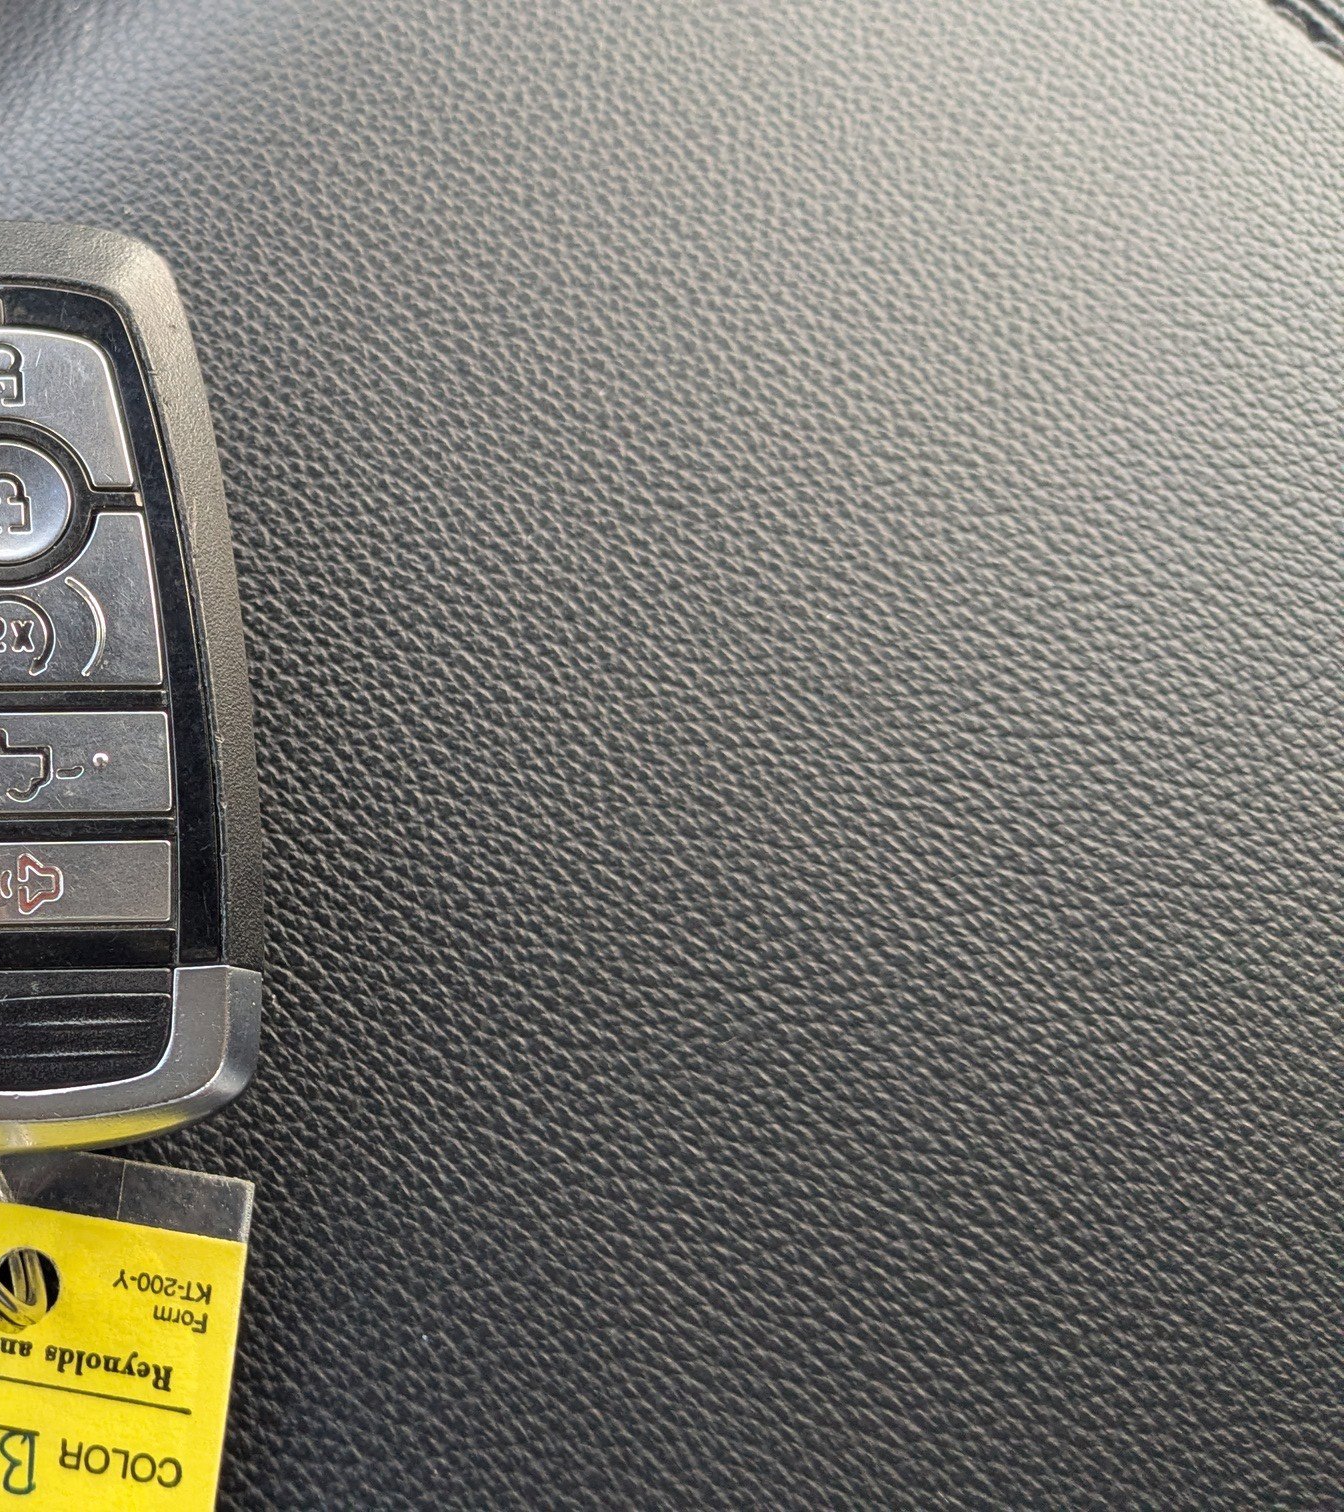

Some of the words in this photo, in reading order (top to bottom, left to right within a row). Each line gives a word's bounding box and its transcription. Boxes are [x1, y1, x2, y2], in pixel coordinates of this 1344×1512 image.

[112, 1268, 212, 1305] KT-200-Y
[153, 1304, 209, 1334] Form
[45, 1344, 173, 1392] Reynolds
[59, 1437, 183, 1488] COLOR
